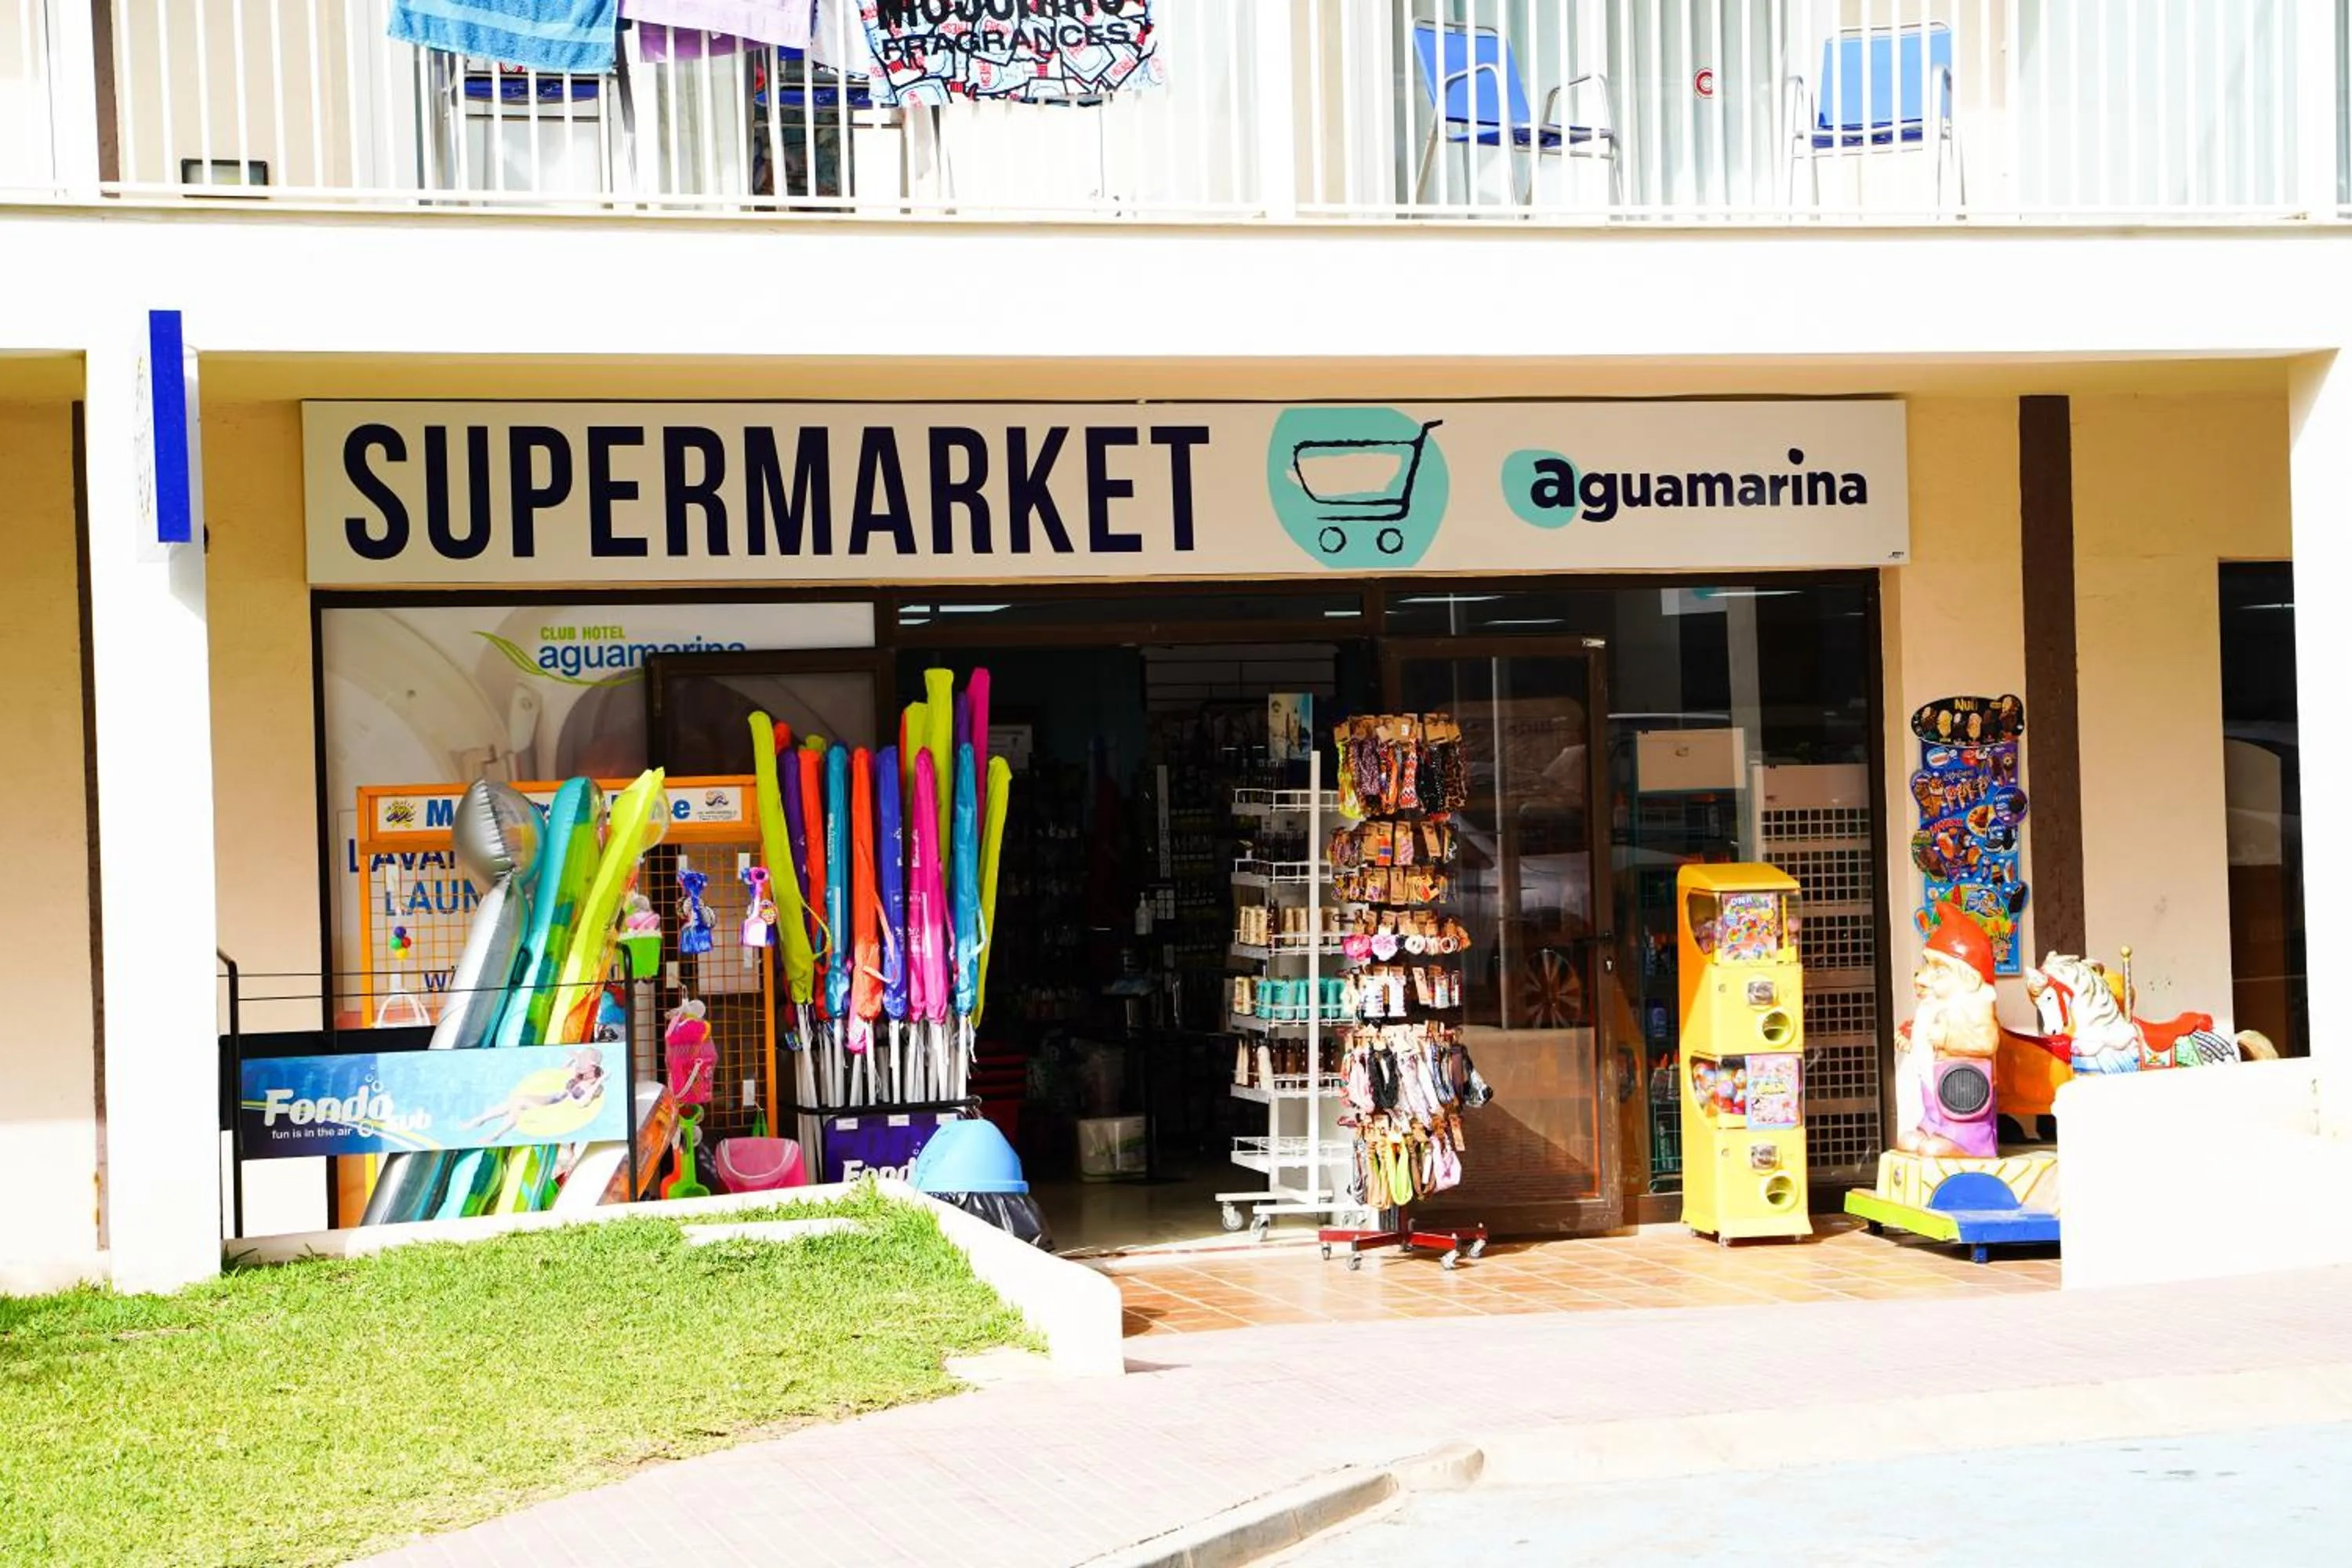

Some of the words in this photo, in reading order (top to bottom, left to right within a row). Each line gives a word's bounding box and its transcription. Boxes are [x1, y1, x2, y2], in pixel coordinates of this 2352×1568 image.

[883, 23, 1131, 60] FRAGRANCES
[343, 423, 1209, 560] SUPERMARKET
[1531, 448, 1867, 523] aguamarina
[541, 626, 575, 640] CLUB
[583, 626, 626, 640] HOTEL
[349, 839, 455, 872] LAVA
[272, 1131, 289, 1139] fun
[292, 1130, 302, 1138] is
[318, 1127, 333, 1136] the
[336, 1127, 352, 1136] air
